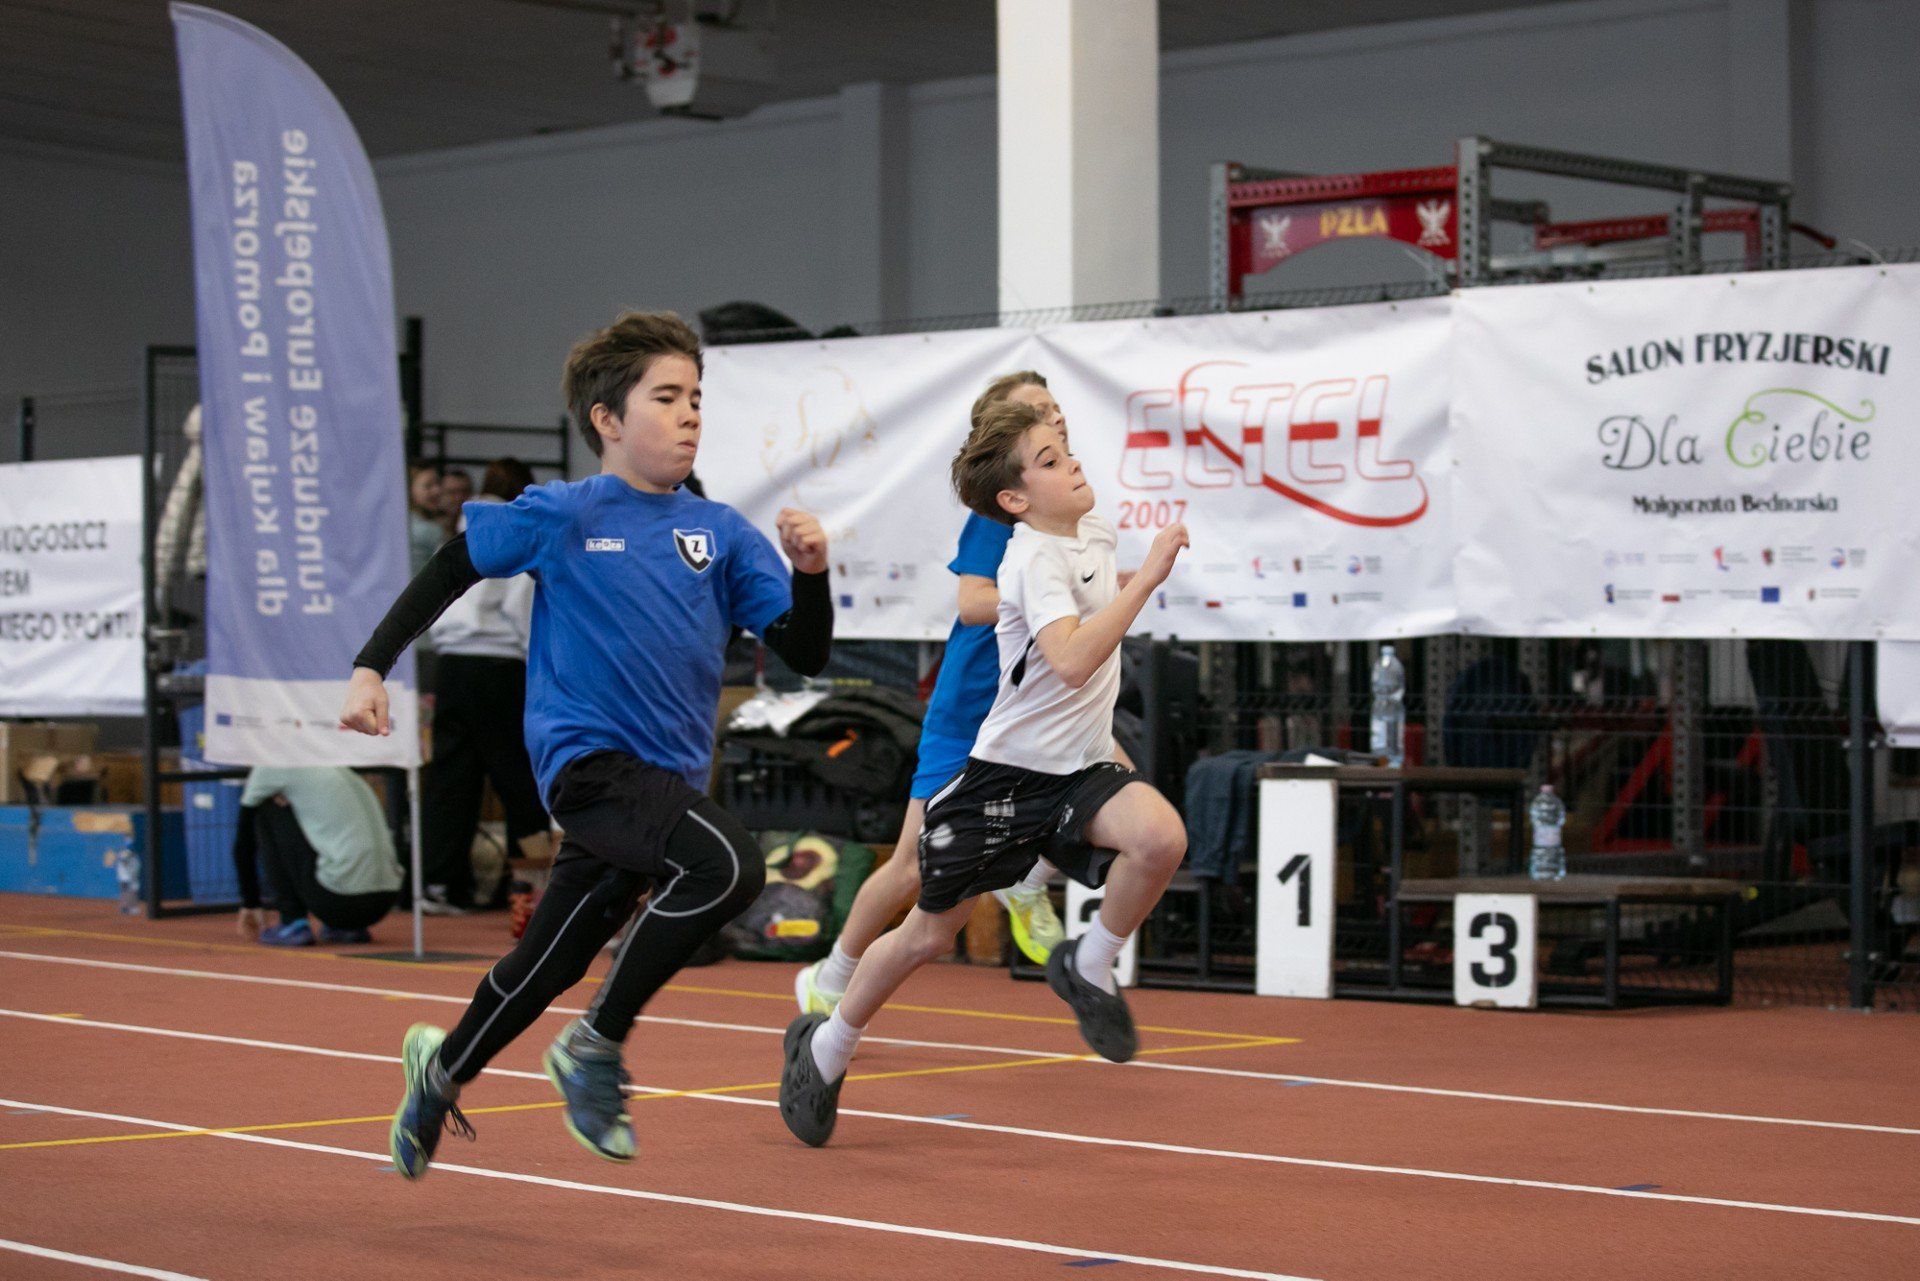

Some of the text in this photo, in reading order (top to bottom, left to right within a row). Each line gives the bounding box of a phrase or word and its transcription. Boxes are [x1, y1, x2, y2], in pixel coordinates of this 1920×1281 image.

[1318, 205, 1389, 238] PZLA
[1586, 332, 1891, 384] SALON FRYZJERSKI
[1598, 388, 1876, 470] Dla Ciebie
[1118, 500, 1188, 529] 2007
[1740, 492, 1838, 513] Bednarska
[1277, 854, 1311, 927] 1
[1469, 912, 1518, 988] 3
